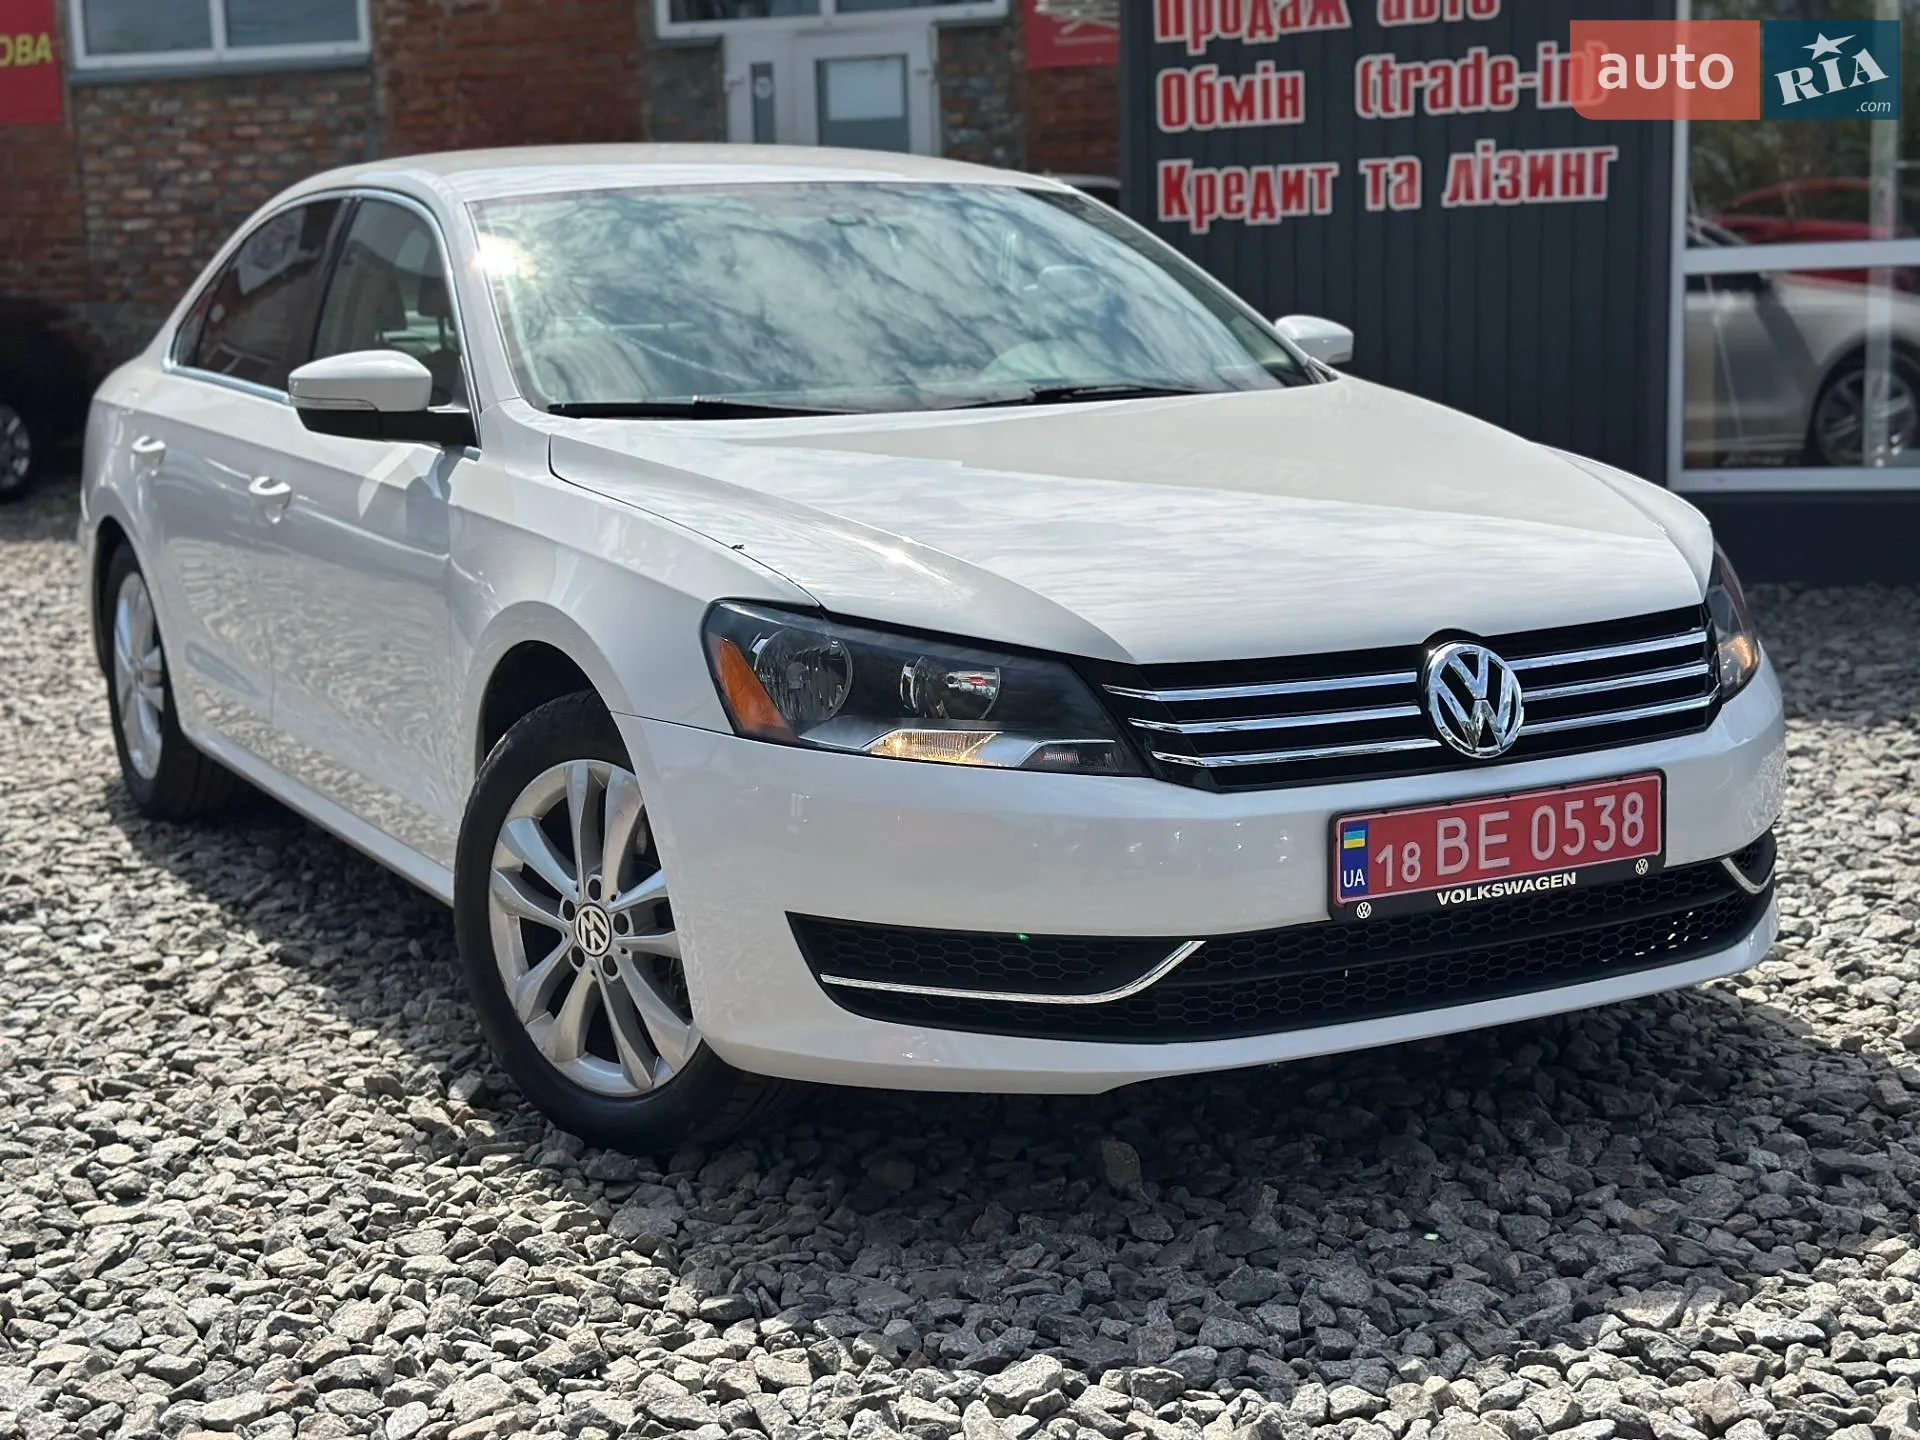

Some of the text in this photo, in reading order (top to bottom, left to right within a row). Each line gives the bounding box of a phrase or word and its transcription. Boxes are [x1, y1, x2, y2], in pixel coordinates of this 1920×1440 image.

[1156, 60, 1305, 134] Обмін
[1158, 138, 1618, 234] Кредит та лізинг
[1374, 791, 1645, 888] 18 BE 0538
[1342, 868, 1366, 888] UA
[1437, 870, 1577, 906] VOLKSWAGEN
